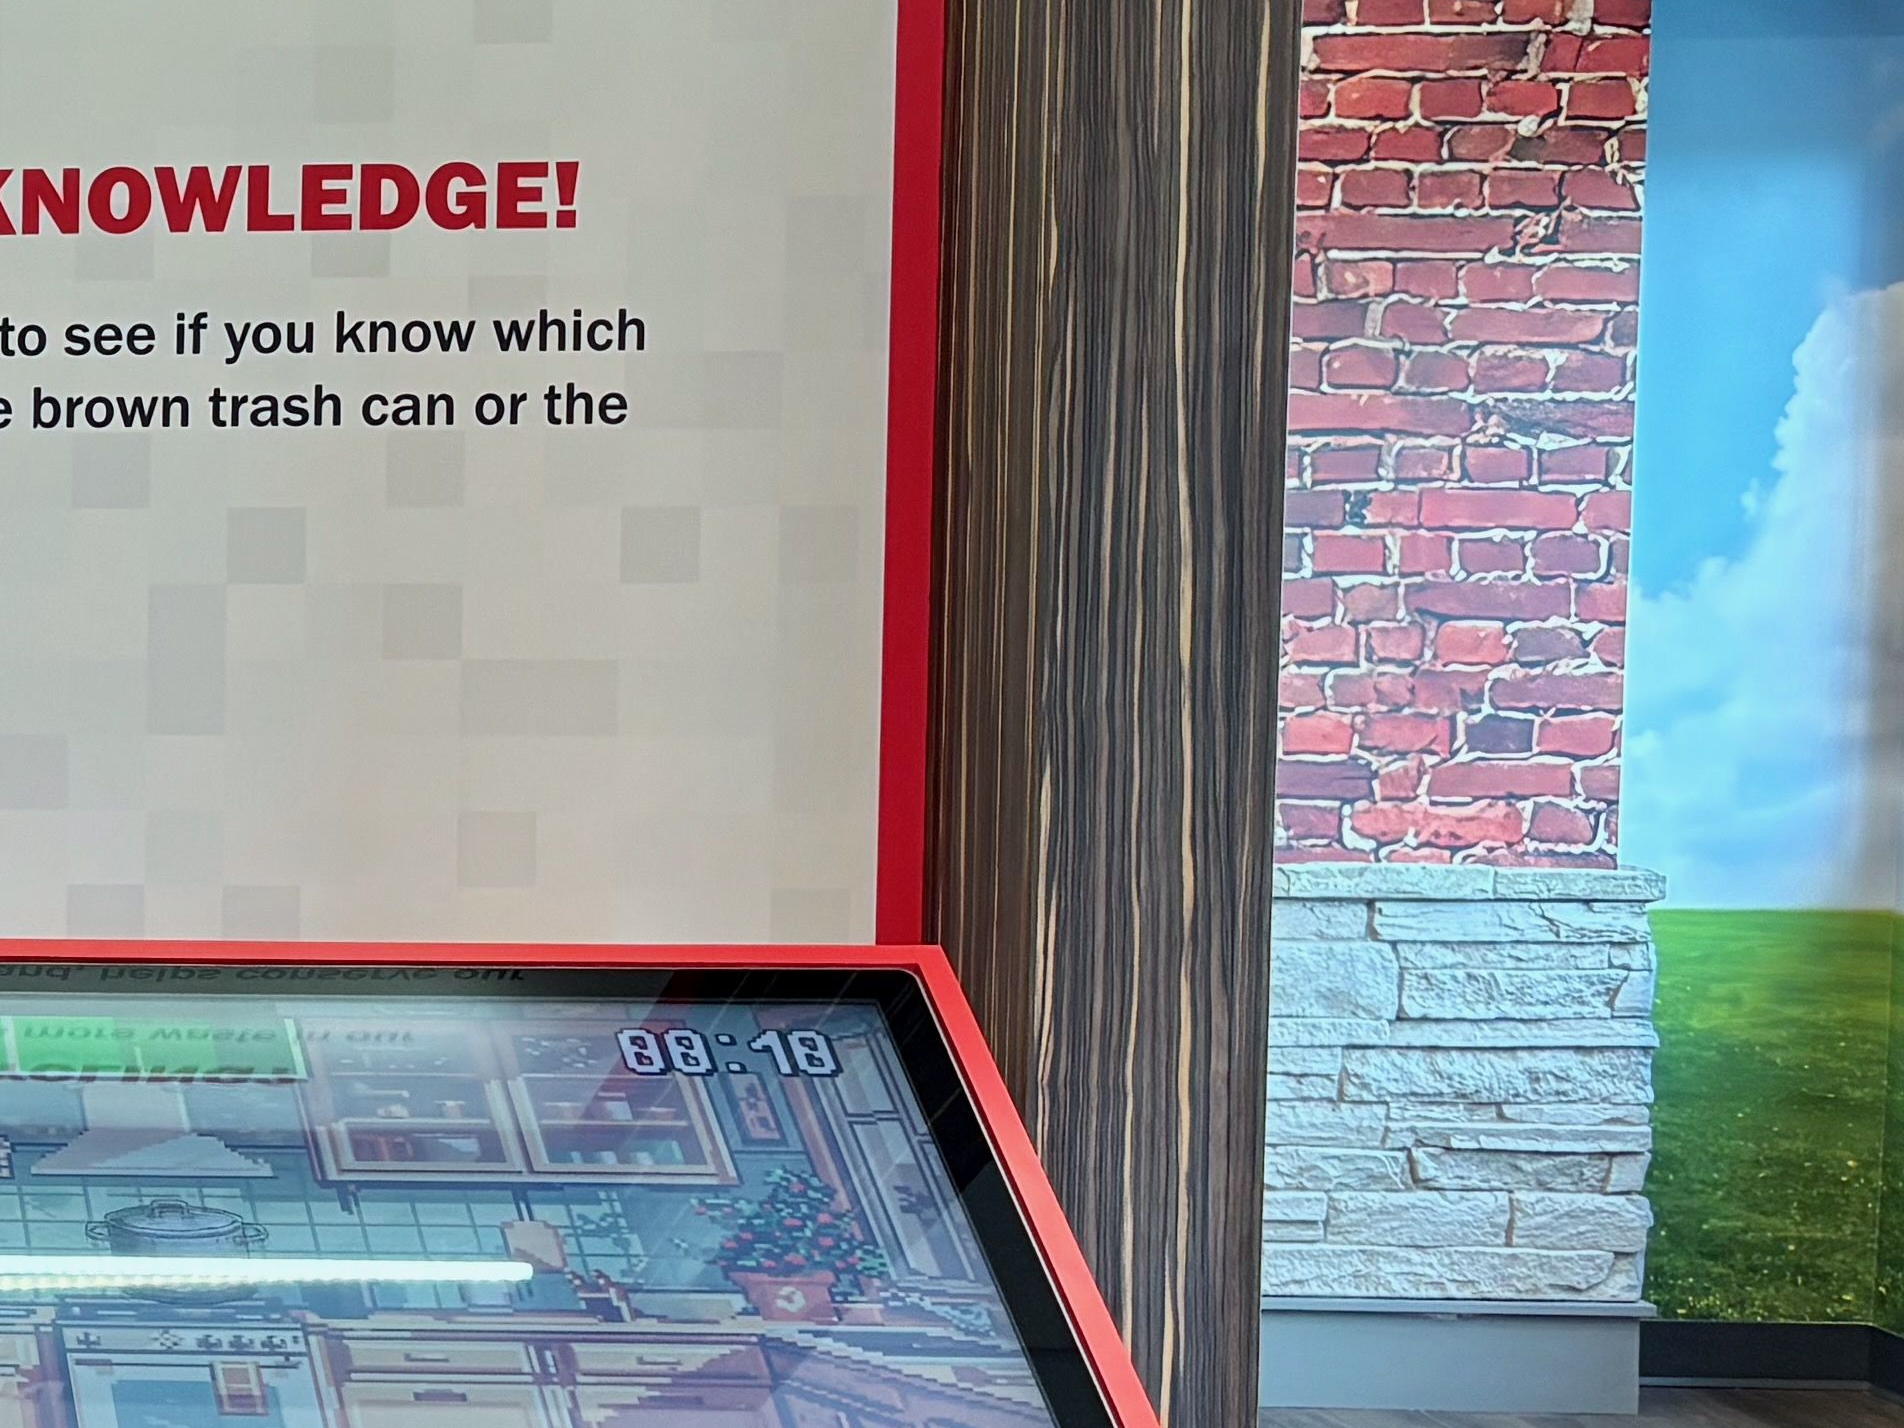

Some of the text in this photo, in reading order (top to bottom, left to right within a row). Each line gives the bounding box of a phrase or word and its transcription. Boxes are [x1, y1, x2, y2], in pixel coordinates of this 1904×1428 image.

[62, 322, 157, 358] see
[175, 310, 210, 356] if
[222, 320, 315, 366] you
[334, 309, 477, 355] know
[491, 307, 646, 353] which
[31, 385, 191, 430] brown
[207, 382, 343, 429] trash
[360, 392, 456, 428] can
[473, 391, 529, 427] or
[542, 381, 629, 427] the
[616, 1026, 840, 1078] 00:10
